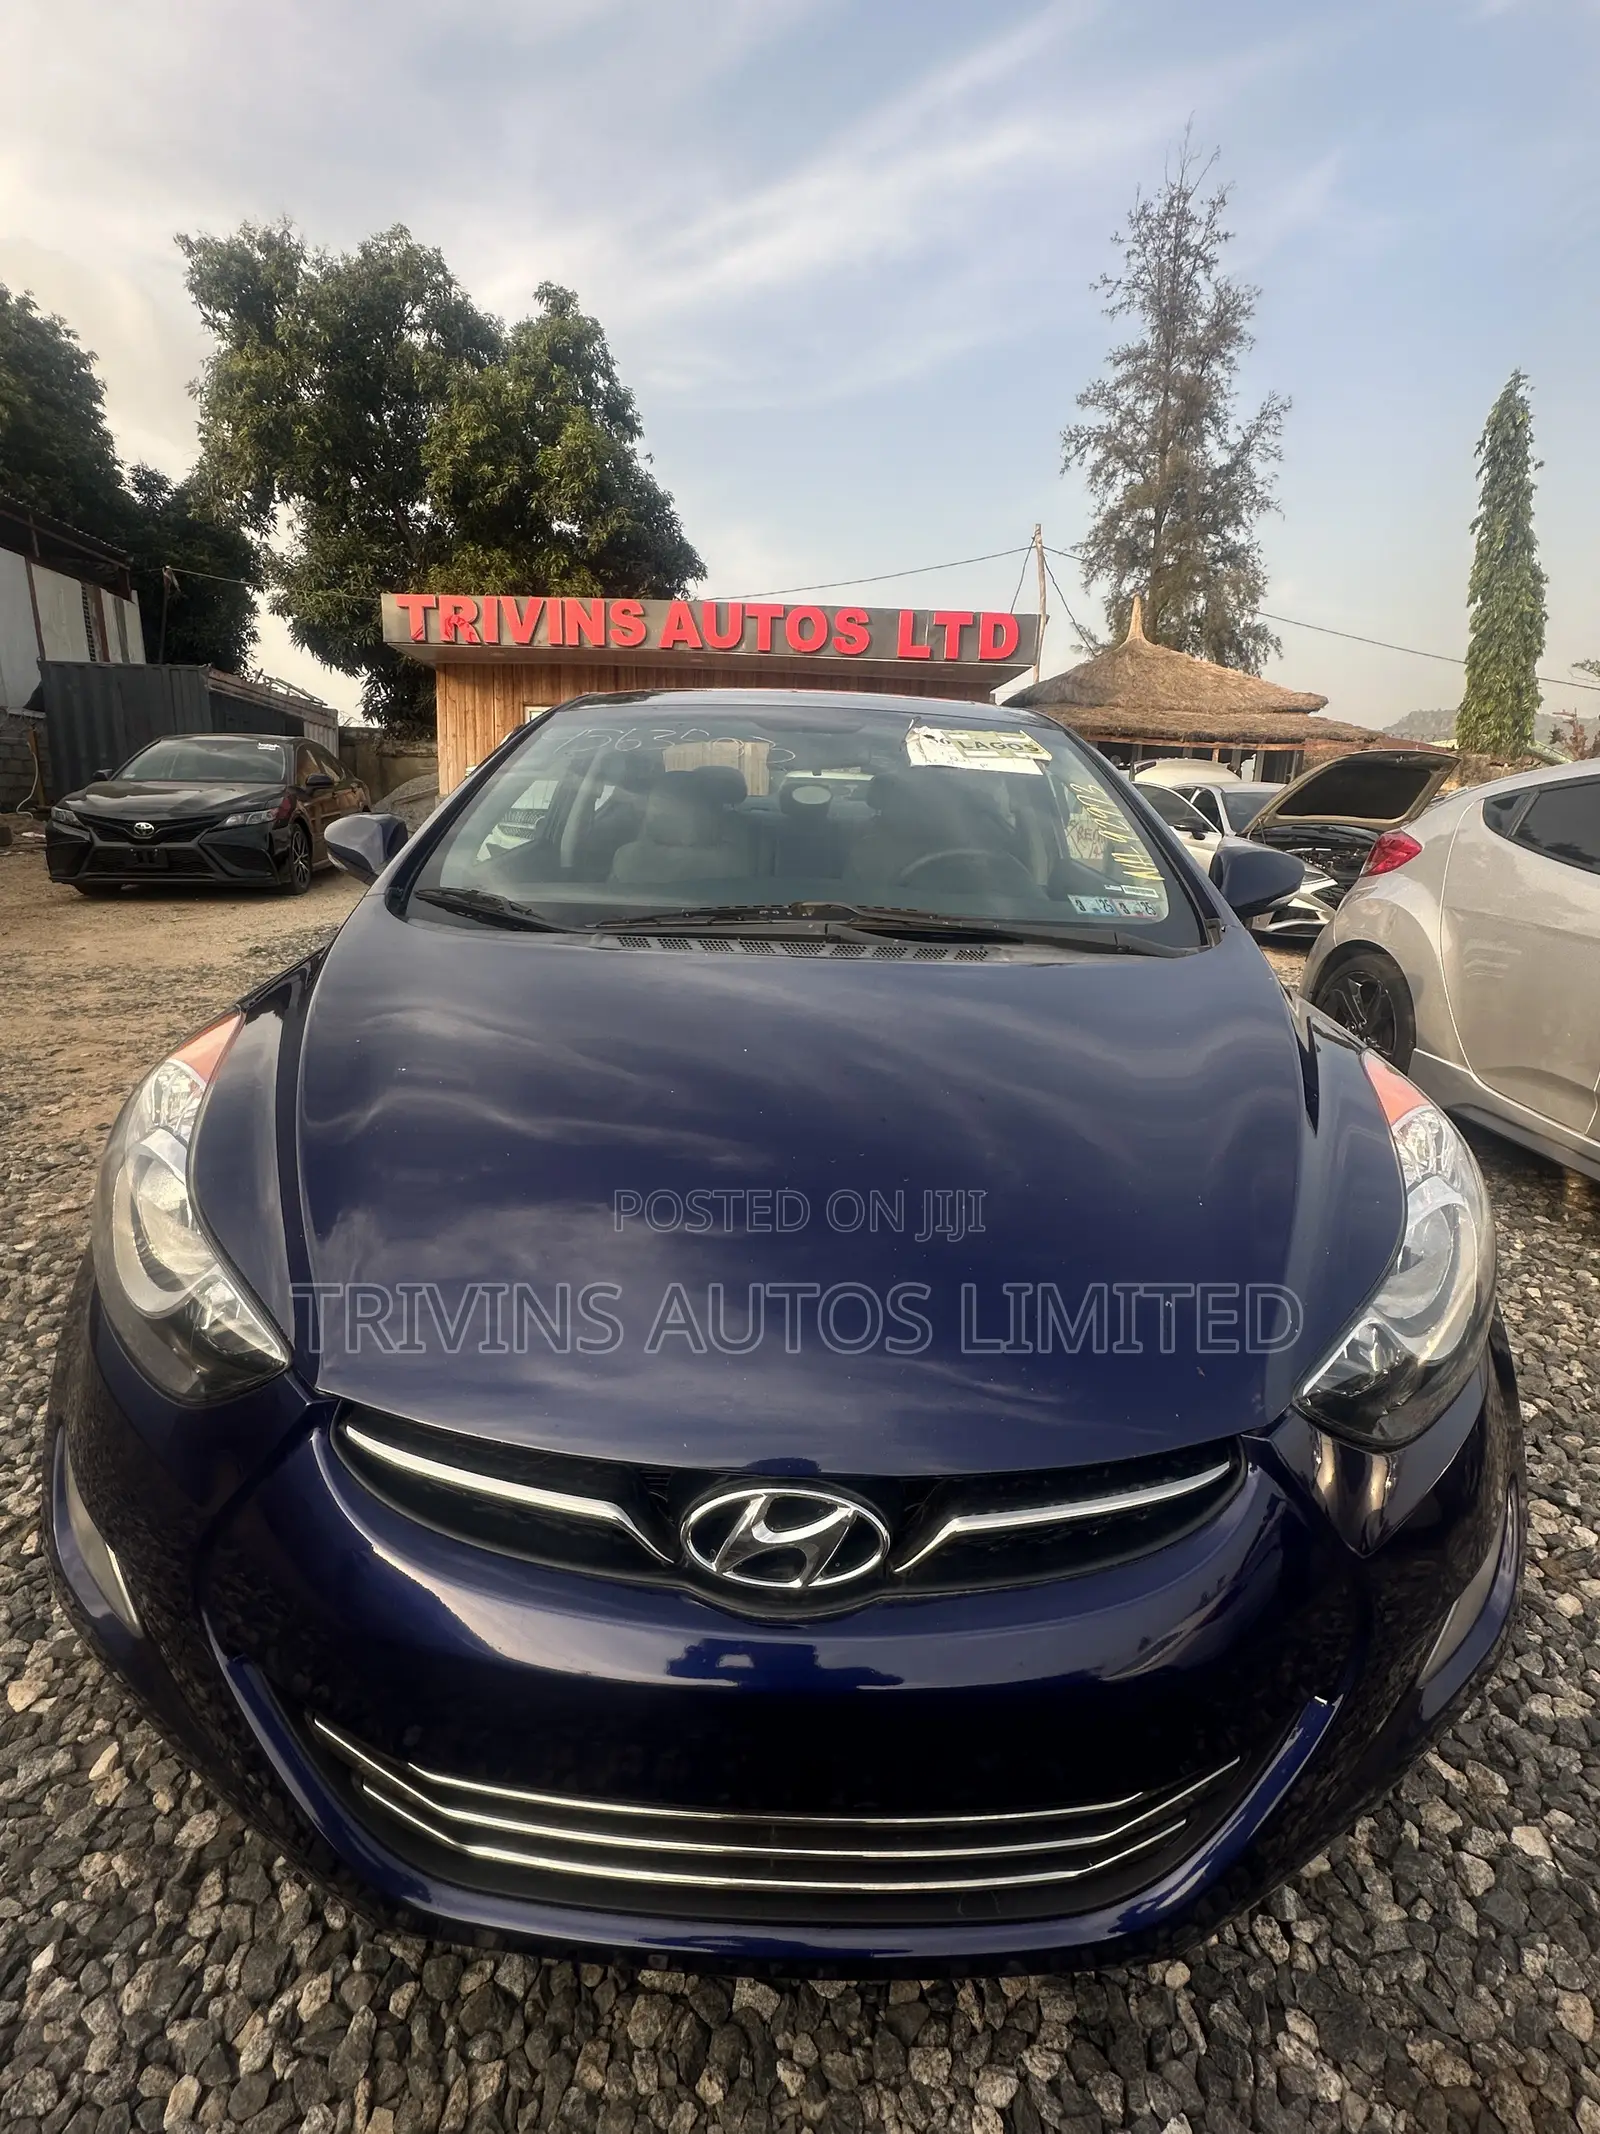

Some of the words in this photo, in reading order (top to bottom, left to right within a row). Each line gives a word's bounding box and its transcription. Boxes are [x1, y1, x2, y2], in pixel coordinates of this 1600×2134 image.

[396, 594, 648, 648] TRIVINS
[657, 600, 872, 656] AUTOS
[896, 609, 1020, 661] LTD
[956, 741, 1040, 752] LAGOS
